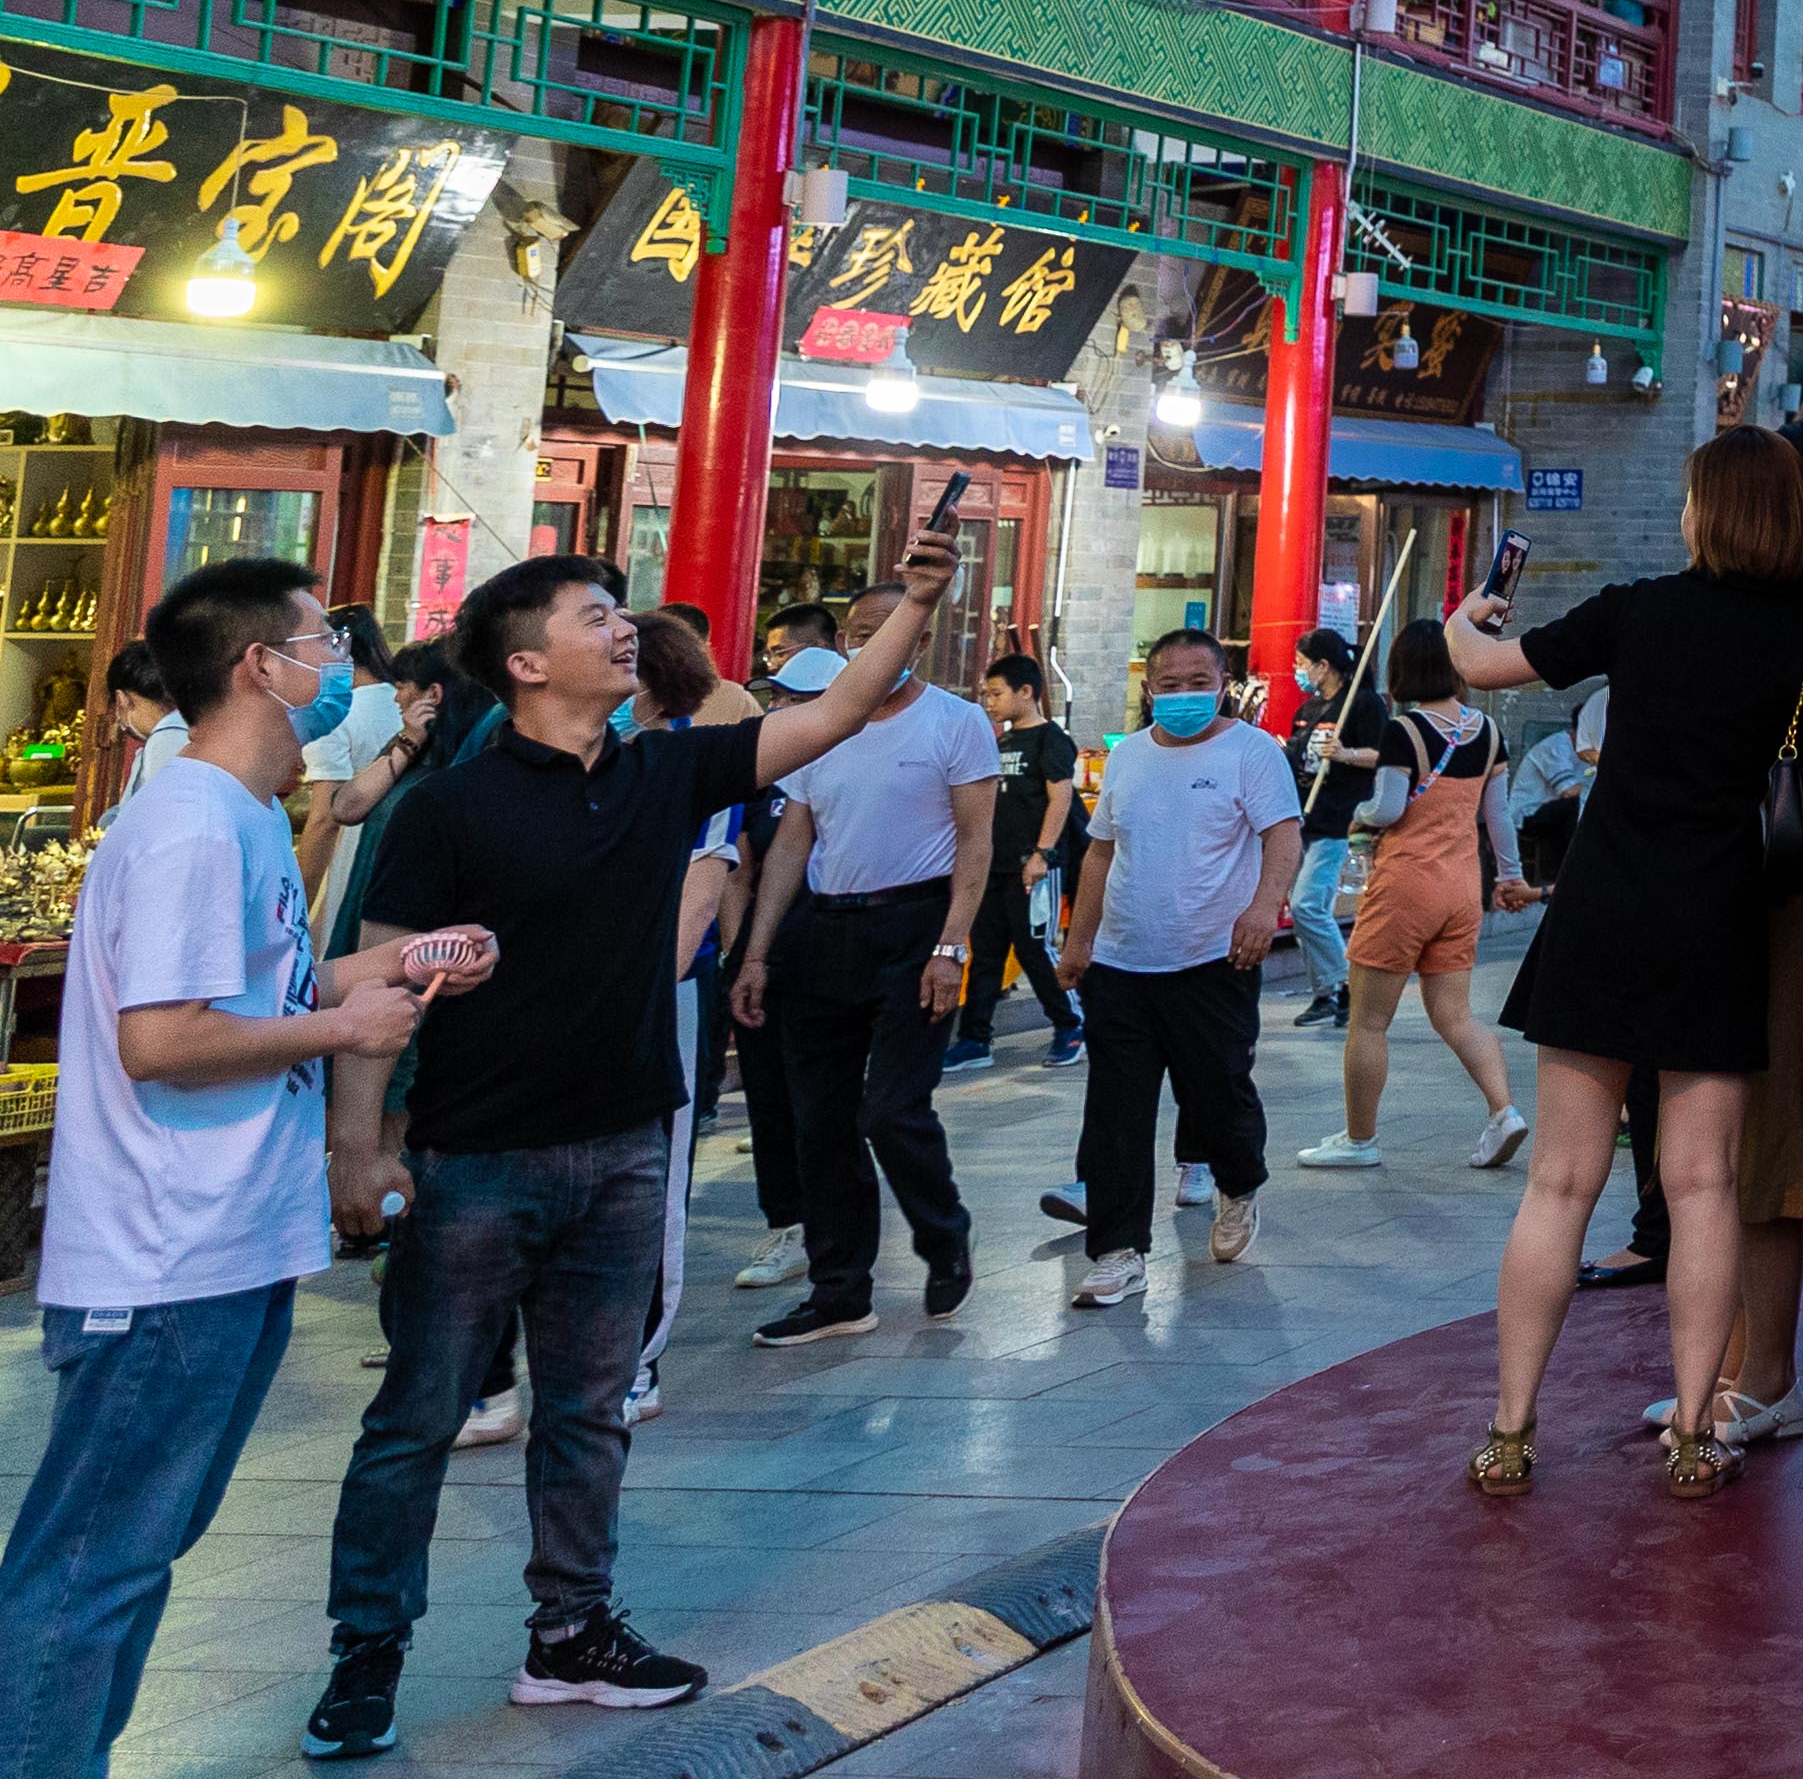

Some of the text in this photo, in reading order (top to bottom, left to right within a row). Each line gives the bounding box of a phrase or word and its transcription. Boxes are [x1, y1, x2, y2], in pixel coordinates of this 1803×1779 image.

[0, 251, 120, 294] 吉星高
[631, 187, 1076, 334] 国珍藏馆
